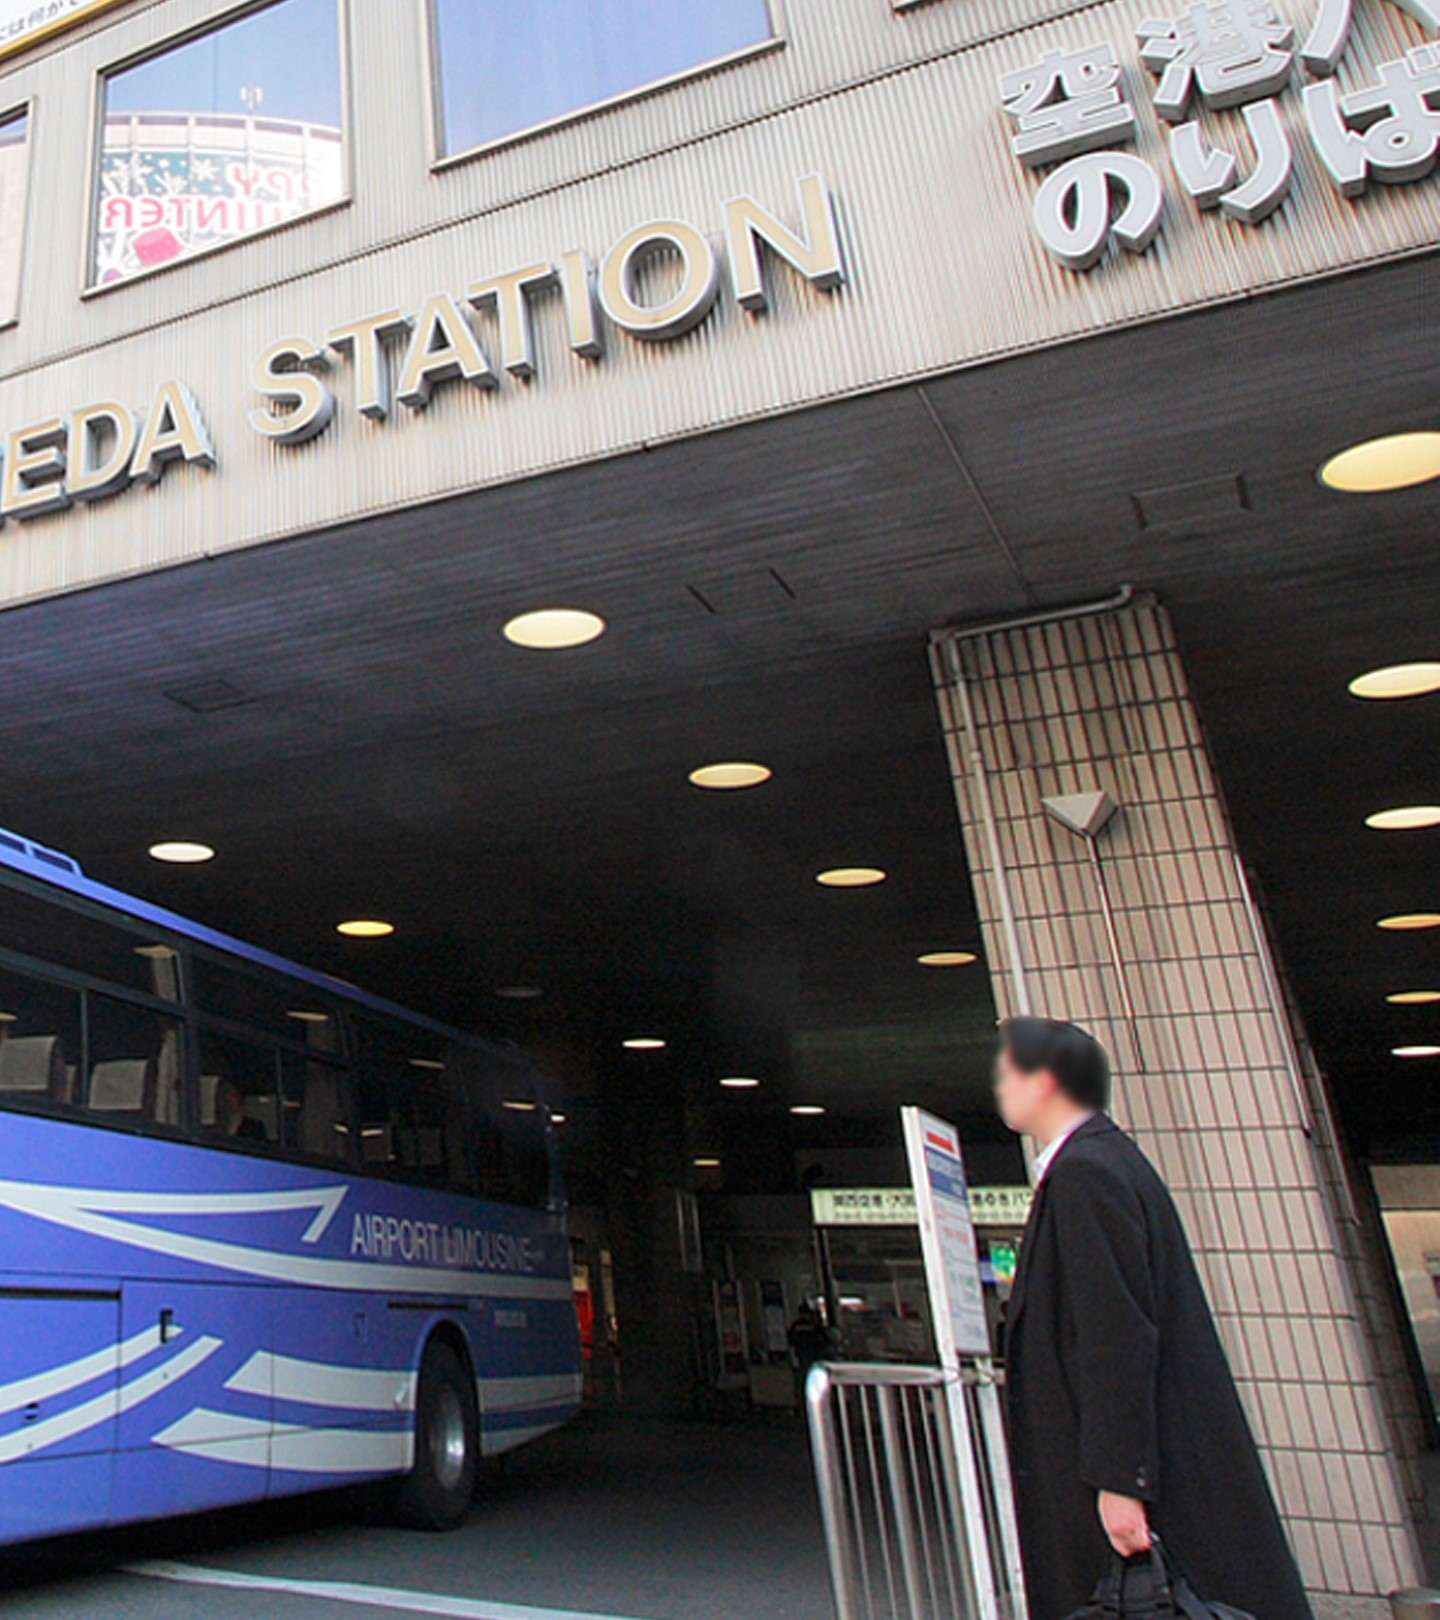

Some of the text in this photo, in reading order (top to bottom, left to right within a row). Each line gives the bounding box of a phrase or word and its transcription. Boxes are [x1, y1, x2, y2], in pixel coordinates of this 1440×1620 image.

[248, 172, 845, 444] STATION
[351, 1213, 439, 1261] AIRPORT
[442, 1226, 534, 1273] LIMOUSINE
